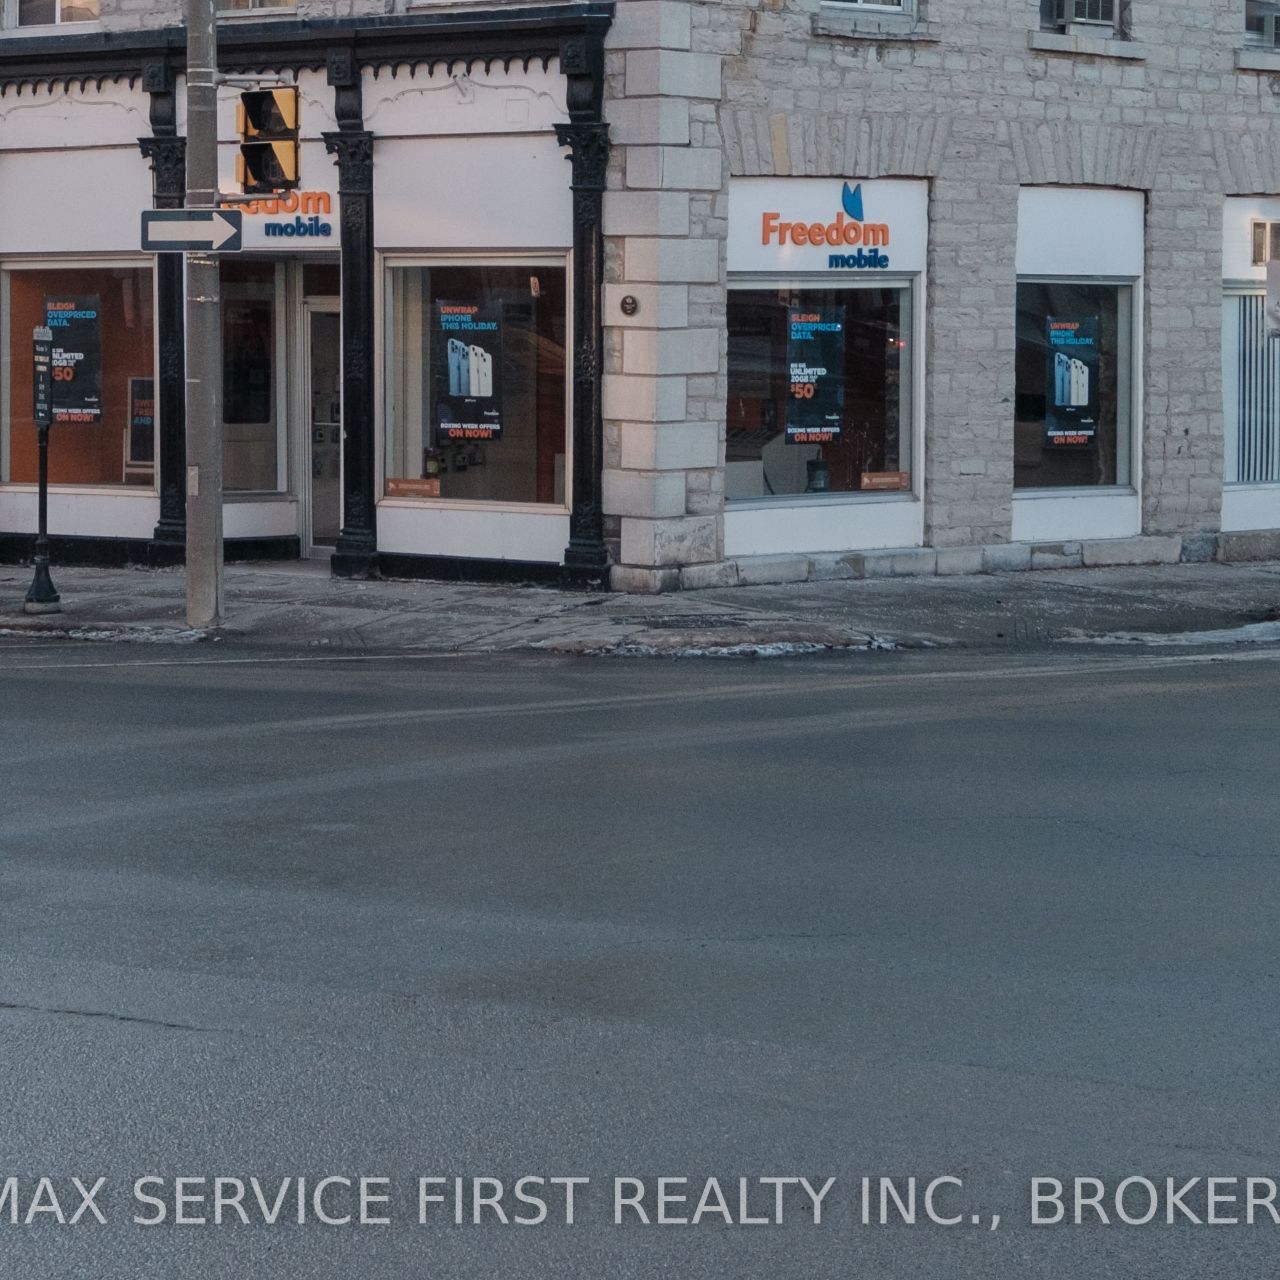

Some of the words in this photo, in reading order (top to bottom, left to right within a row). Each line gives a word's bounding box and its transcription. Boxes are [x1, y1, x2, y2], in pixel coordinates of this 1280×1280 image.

[263, 216, 332, 237] mobile
[761, 211, 890, 246] Freedom
[828, 247, 890, 269] mobile
[47, 310, 97, 319] OVERPRICED
[440, 306, 478, 314] UNWRAP
[47, 318, 70, 327] DATA.
[52, 352, 84, 360] NLIMITED
[52, 367, 73, 381] 50
[790, 368, 827, 376] UNLIMITED
[448, 429, 464, 438] ON
[464, 429, 493, 439] NOW!
[794, 433, 808, 442] ON
[808, 433, 833, 442] NOW!
[1053, 436, 1066, 444] ON
